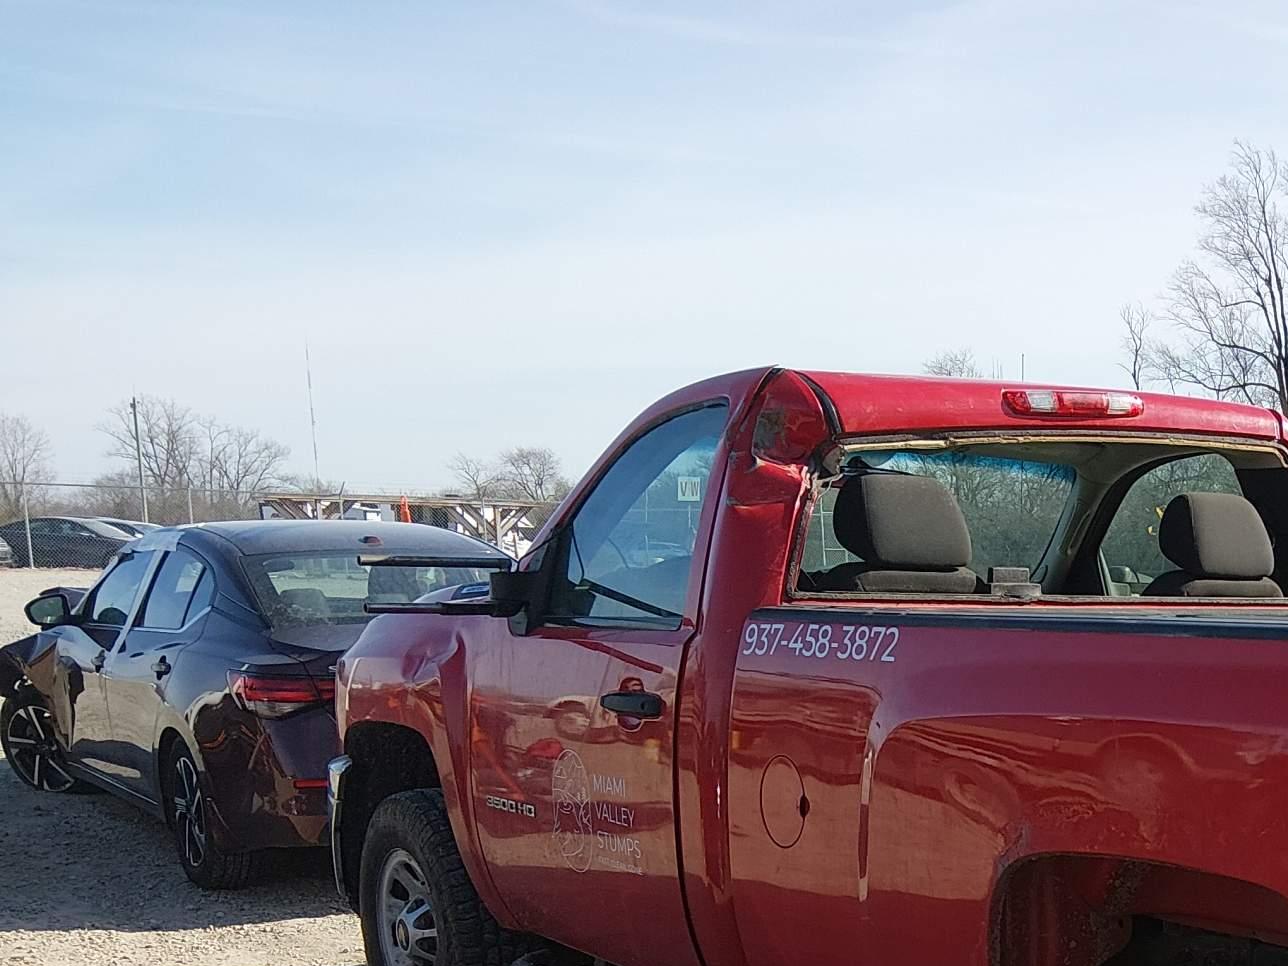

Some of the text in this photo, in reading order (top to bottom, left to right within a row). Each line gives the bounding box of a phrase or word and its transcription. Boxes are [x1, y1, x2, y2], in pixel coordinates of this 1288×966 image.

[742, 623, 899, 662] 937-458-3872
[593, 775, 626, 797] MIAMI
[486, 795, 535, 817] 3500 HD
[594, 801, 634, 828] VALLEY
[597, 831, 641, 859] STUMPS
